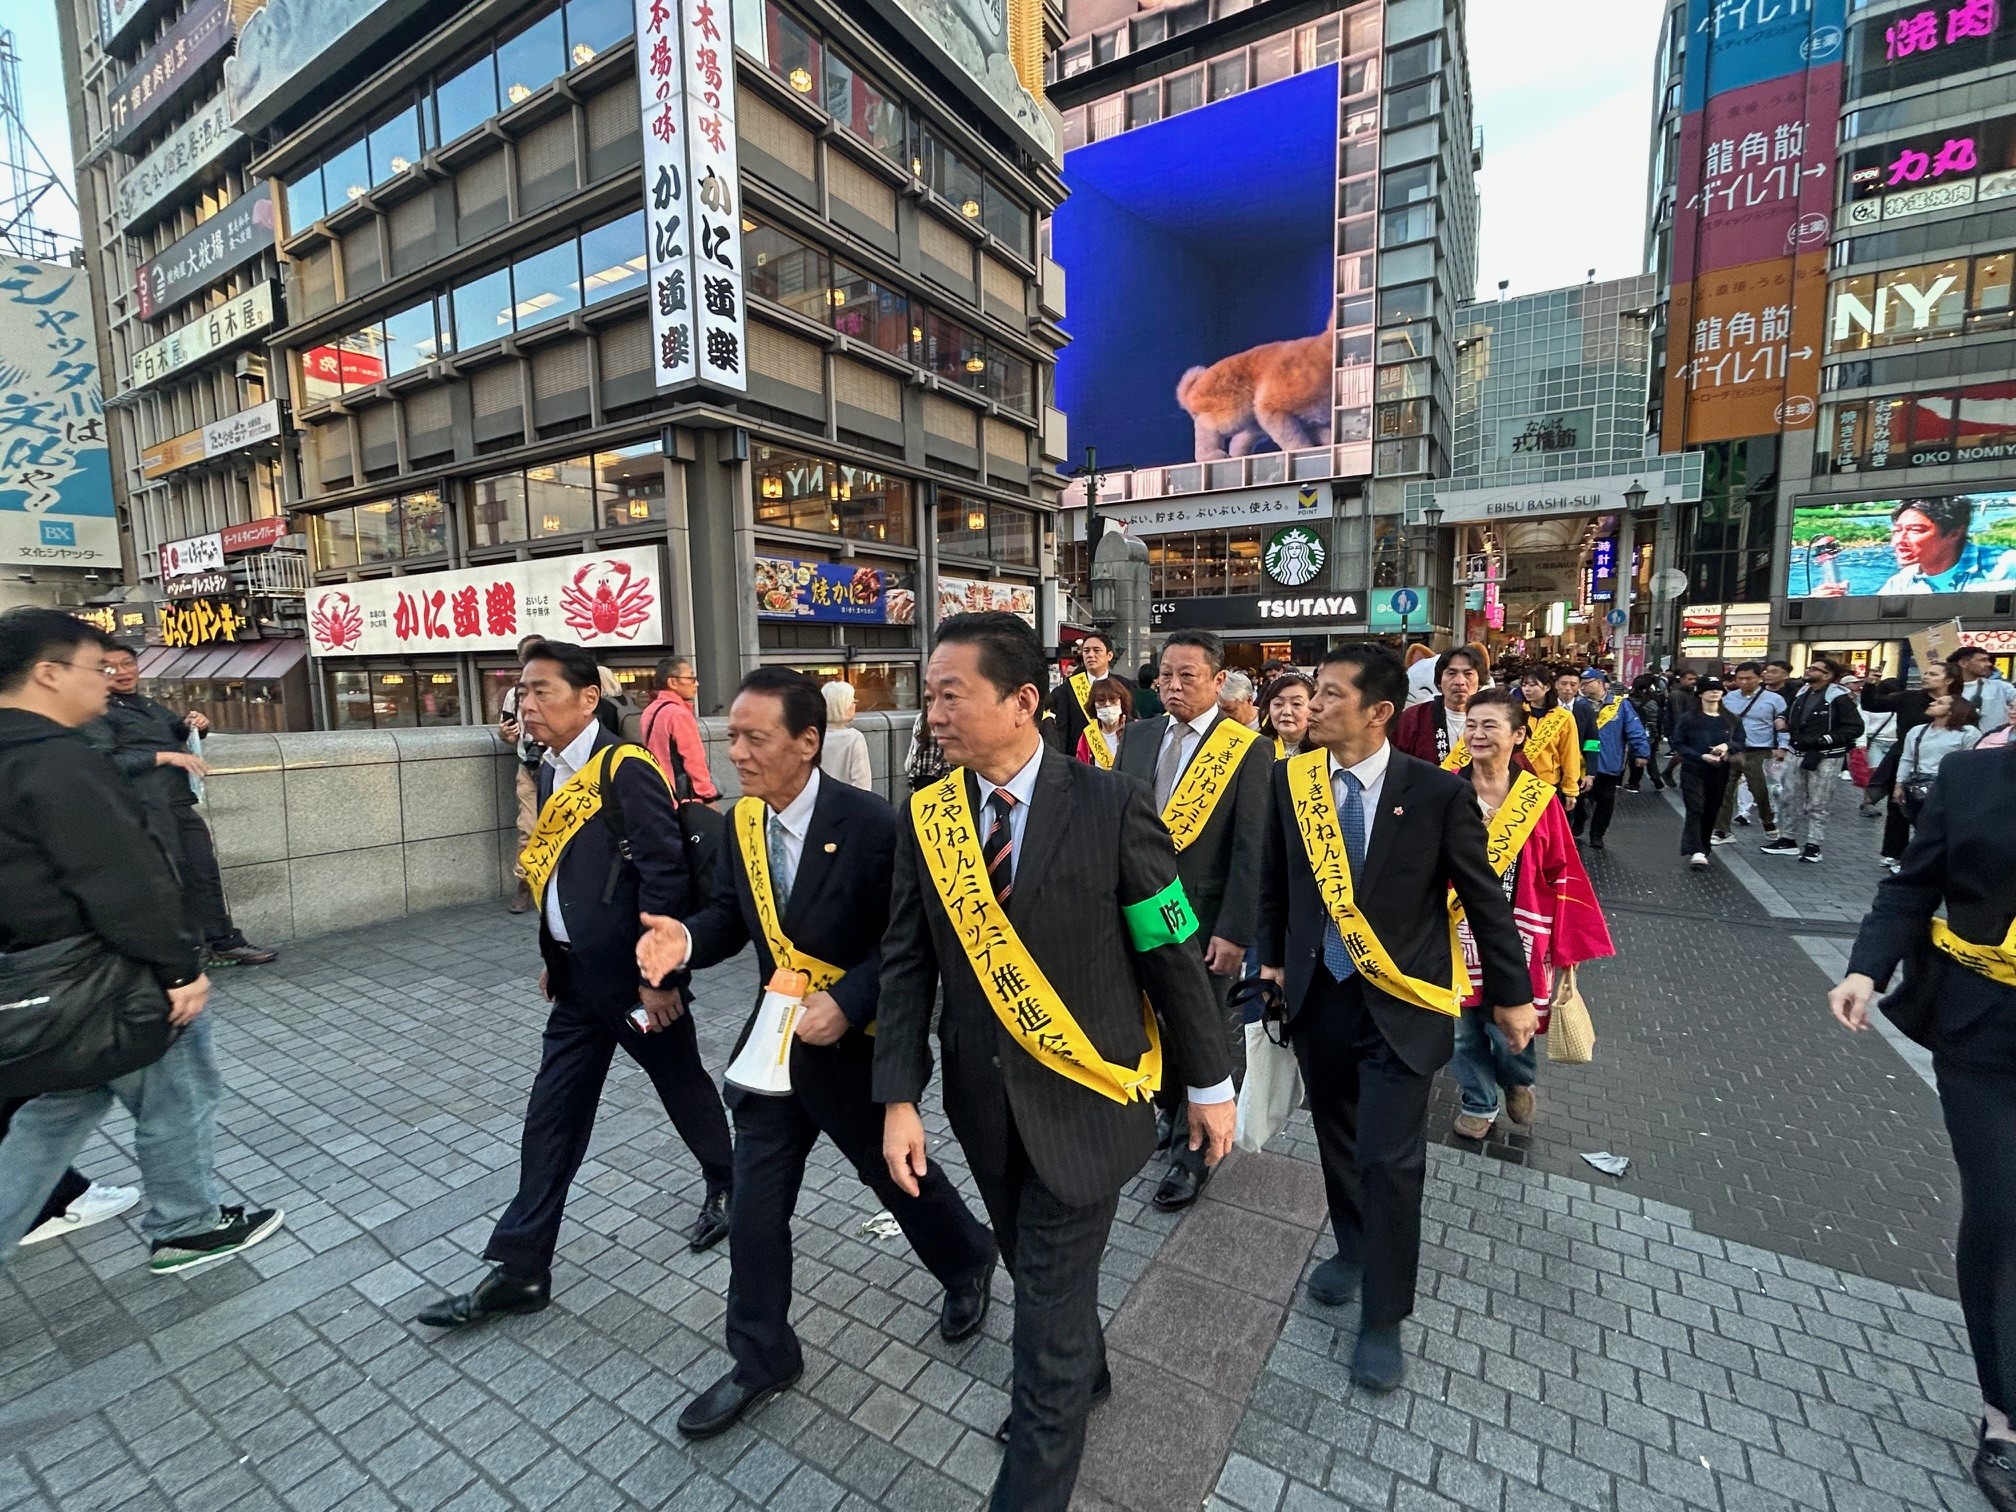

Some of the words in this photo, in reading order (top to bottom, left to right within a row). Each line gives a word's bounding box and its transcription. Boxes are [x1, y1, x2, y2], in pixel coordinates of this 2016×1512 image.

[1886, 0, 1997, 60] 焼肉
[647, 0, 676, 144] 本場の味
[692, 0, 726, 154] 本場の味
[1706, 120, 1810, 179] 龍角散
[1853, 169, 1879, 182] OPEN
[187, 229, 224, 278] 大牧場
[210, 298, 257, 348] 白木屋
[1695, 304, 1797, 353] 龍角散
[1834, 275, 1959, 341] NY
[144, 338, 182, 380] 白木屋
[1512, 427, 1577, 453] 戎橋筋
[1526, 417, 1564, 432] なんば
[1872, 399, 1894, 468] お好み焼き
[1912, 451, 1951, 465] OKO
[1957, 444, 2016, 460] NOMIY
[1487, 500, 1525, 514] EBISU
[18, 546, 103, 561] 文化シャッター
[44, 526, 72, 541] BX
[525, 595, 549, 606] おいしさ
[526, 606, 551, 618] 年中無休
[811, 576, 864, 606] 焼かに
[1257, 596, 1358, 619] TSUTAYA
[160, 598, 247, 647] びっくりドンキー
[1306, 765, 1355, 920] すきやねんミナミ
[919, 803, 1001, 975] クリーンアップ
